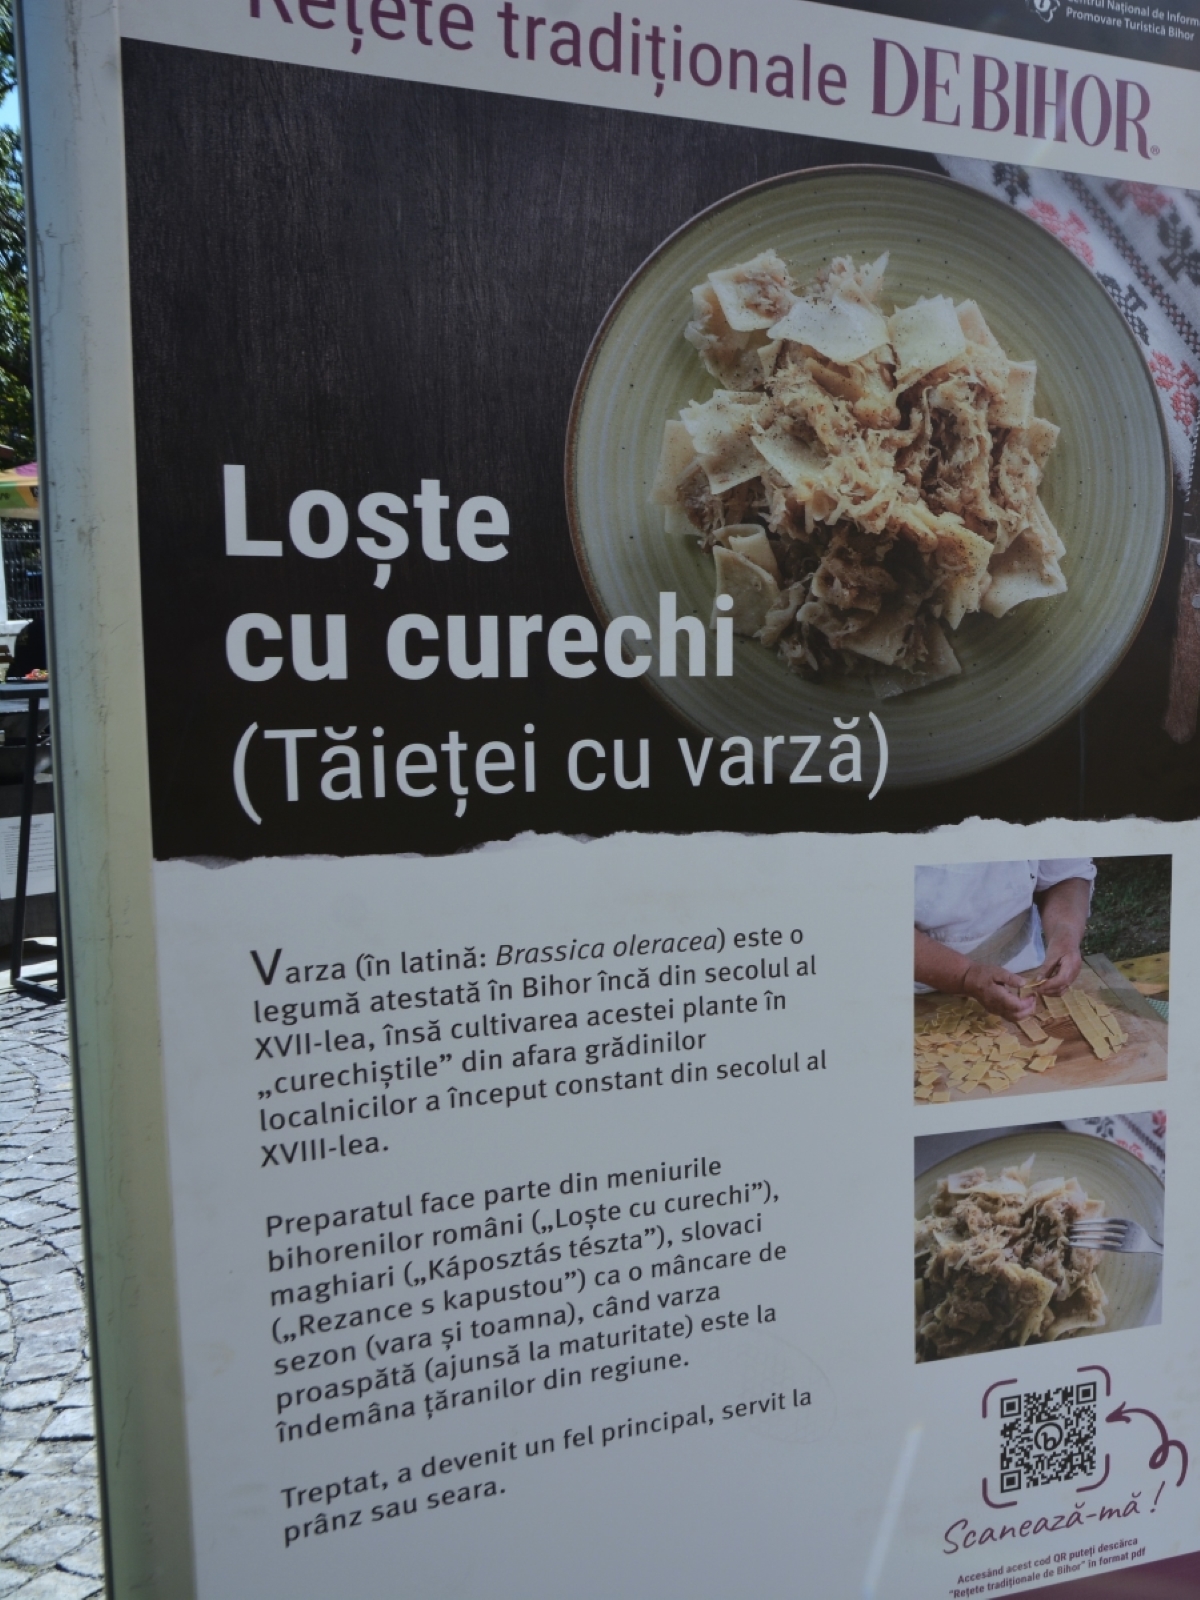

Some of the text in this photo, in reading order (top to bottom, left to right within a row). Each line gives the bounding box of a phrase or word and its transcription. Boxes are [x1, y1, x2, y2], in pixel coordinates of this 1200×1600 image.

[1065, 6, 1195, 41] Promovare Turistică Bihor
[1151, 7, 1165, 21] de
[495, 1, 848, 106] tradiționale
[222, 464, 511, 590] Loște
[225, 591, 735, 682] cu curechi
[232, 710, 890, 826] (Tăieței cu varză)
[249, 927, 804, 986] Varza (în latină: Brassica oleracea) este o
[254, 954, 817, 1026] legumă atestată în Bihor încă din secolul al
[255, 990, 786, 1060] XVII-lea, însă cultivarea acestei plante în
[462, 1049, 502, 1073] din
[512, 1044, 576, 1068] afara
[585, 1030, 707, 1065] grădinilor
[260, 1049, 827, 1132] localnicilor a început constant din secolul al
[261, 1134, 389, 1168] XVIII-lea.
[266, 1157, 721, 1238] Preparatul face parte din meniurile
[268, 1231, 424, 1273] bihorenilor
[432, 1213, 522, 1246] români
[629, 1200, 656, 1218] cu
[270, 1265, 394, 1307] maghiari
[681, 1212, 761, 1243] slovaci
[421, 1298, 435, 1315] s
[594, 1269, 620, 1286] ca
[628, 1266, 643, 1281] o
[651, 1250, 751, 1278] mâncare
[759, 1241, 787, 1262] de
[274, 1285, 720, 1376] sezon (vara și toamna), când varza
[276, 1304, 776, 1415] proaspătă (ajunsă la maturitate) este la
[275, 1353, 689, 1443] îndemâna țăranilor din regiune.
[280, 1388, 812, 1509] Treptat, a devenit un fel principal, servit la
[284, 1481, 506, 1548] prânz sau seara.
[957, 1537, 1138, 1586] Accesând acest cod QR puteți descărca
[987, 1573, 1041, 1592] tradiționale
[1043, 1567, 1055, 1579] de
[1088, 1558, 1097, 1569] în
[1099, 1550, 1129, 1566] format
[1131, 1545, 1146, 1561] pdf
